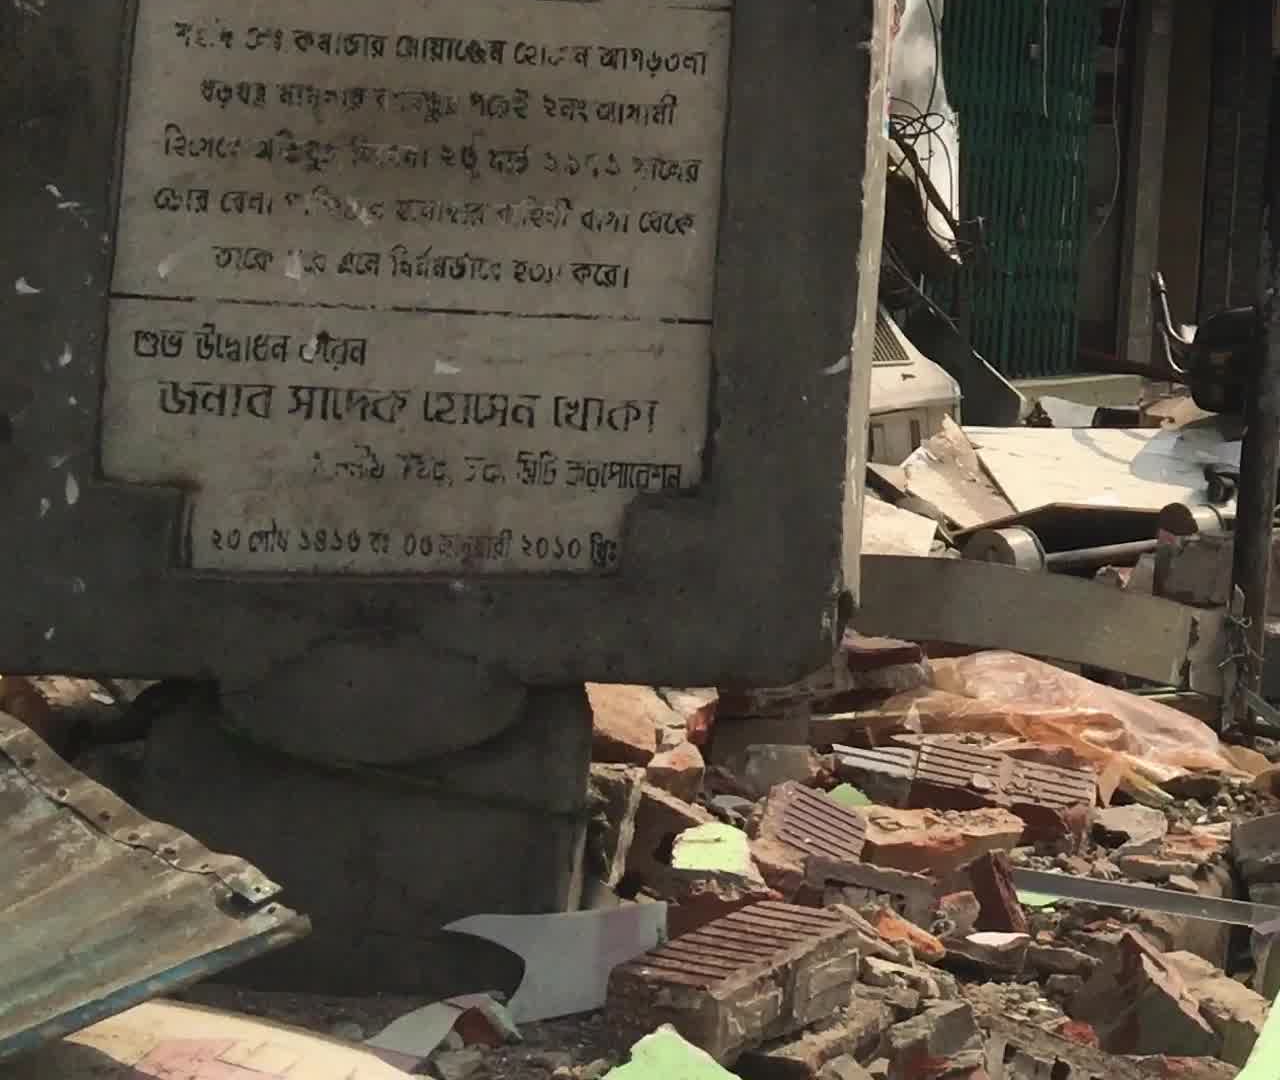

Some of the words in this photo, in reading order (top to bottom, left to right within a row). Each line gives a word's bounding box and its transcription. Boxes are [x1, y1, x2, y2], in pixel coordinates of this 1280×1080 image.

[133, 329, 186, 360] শুভ
[157, 381, 277, 419] জনাব
[287, 385, 408, 426] সাদেক
[422, 391, 540, 431] হোসেন
[551, 395, 659, 436] খোকা
